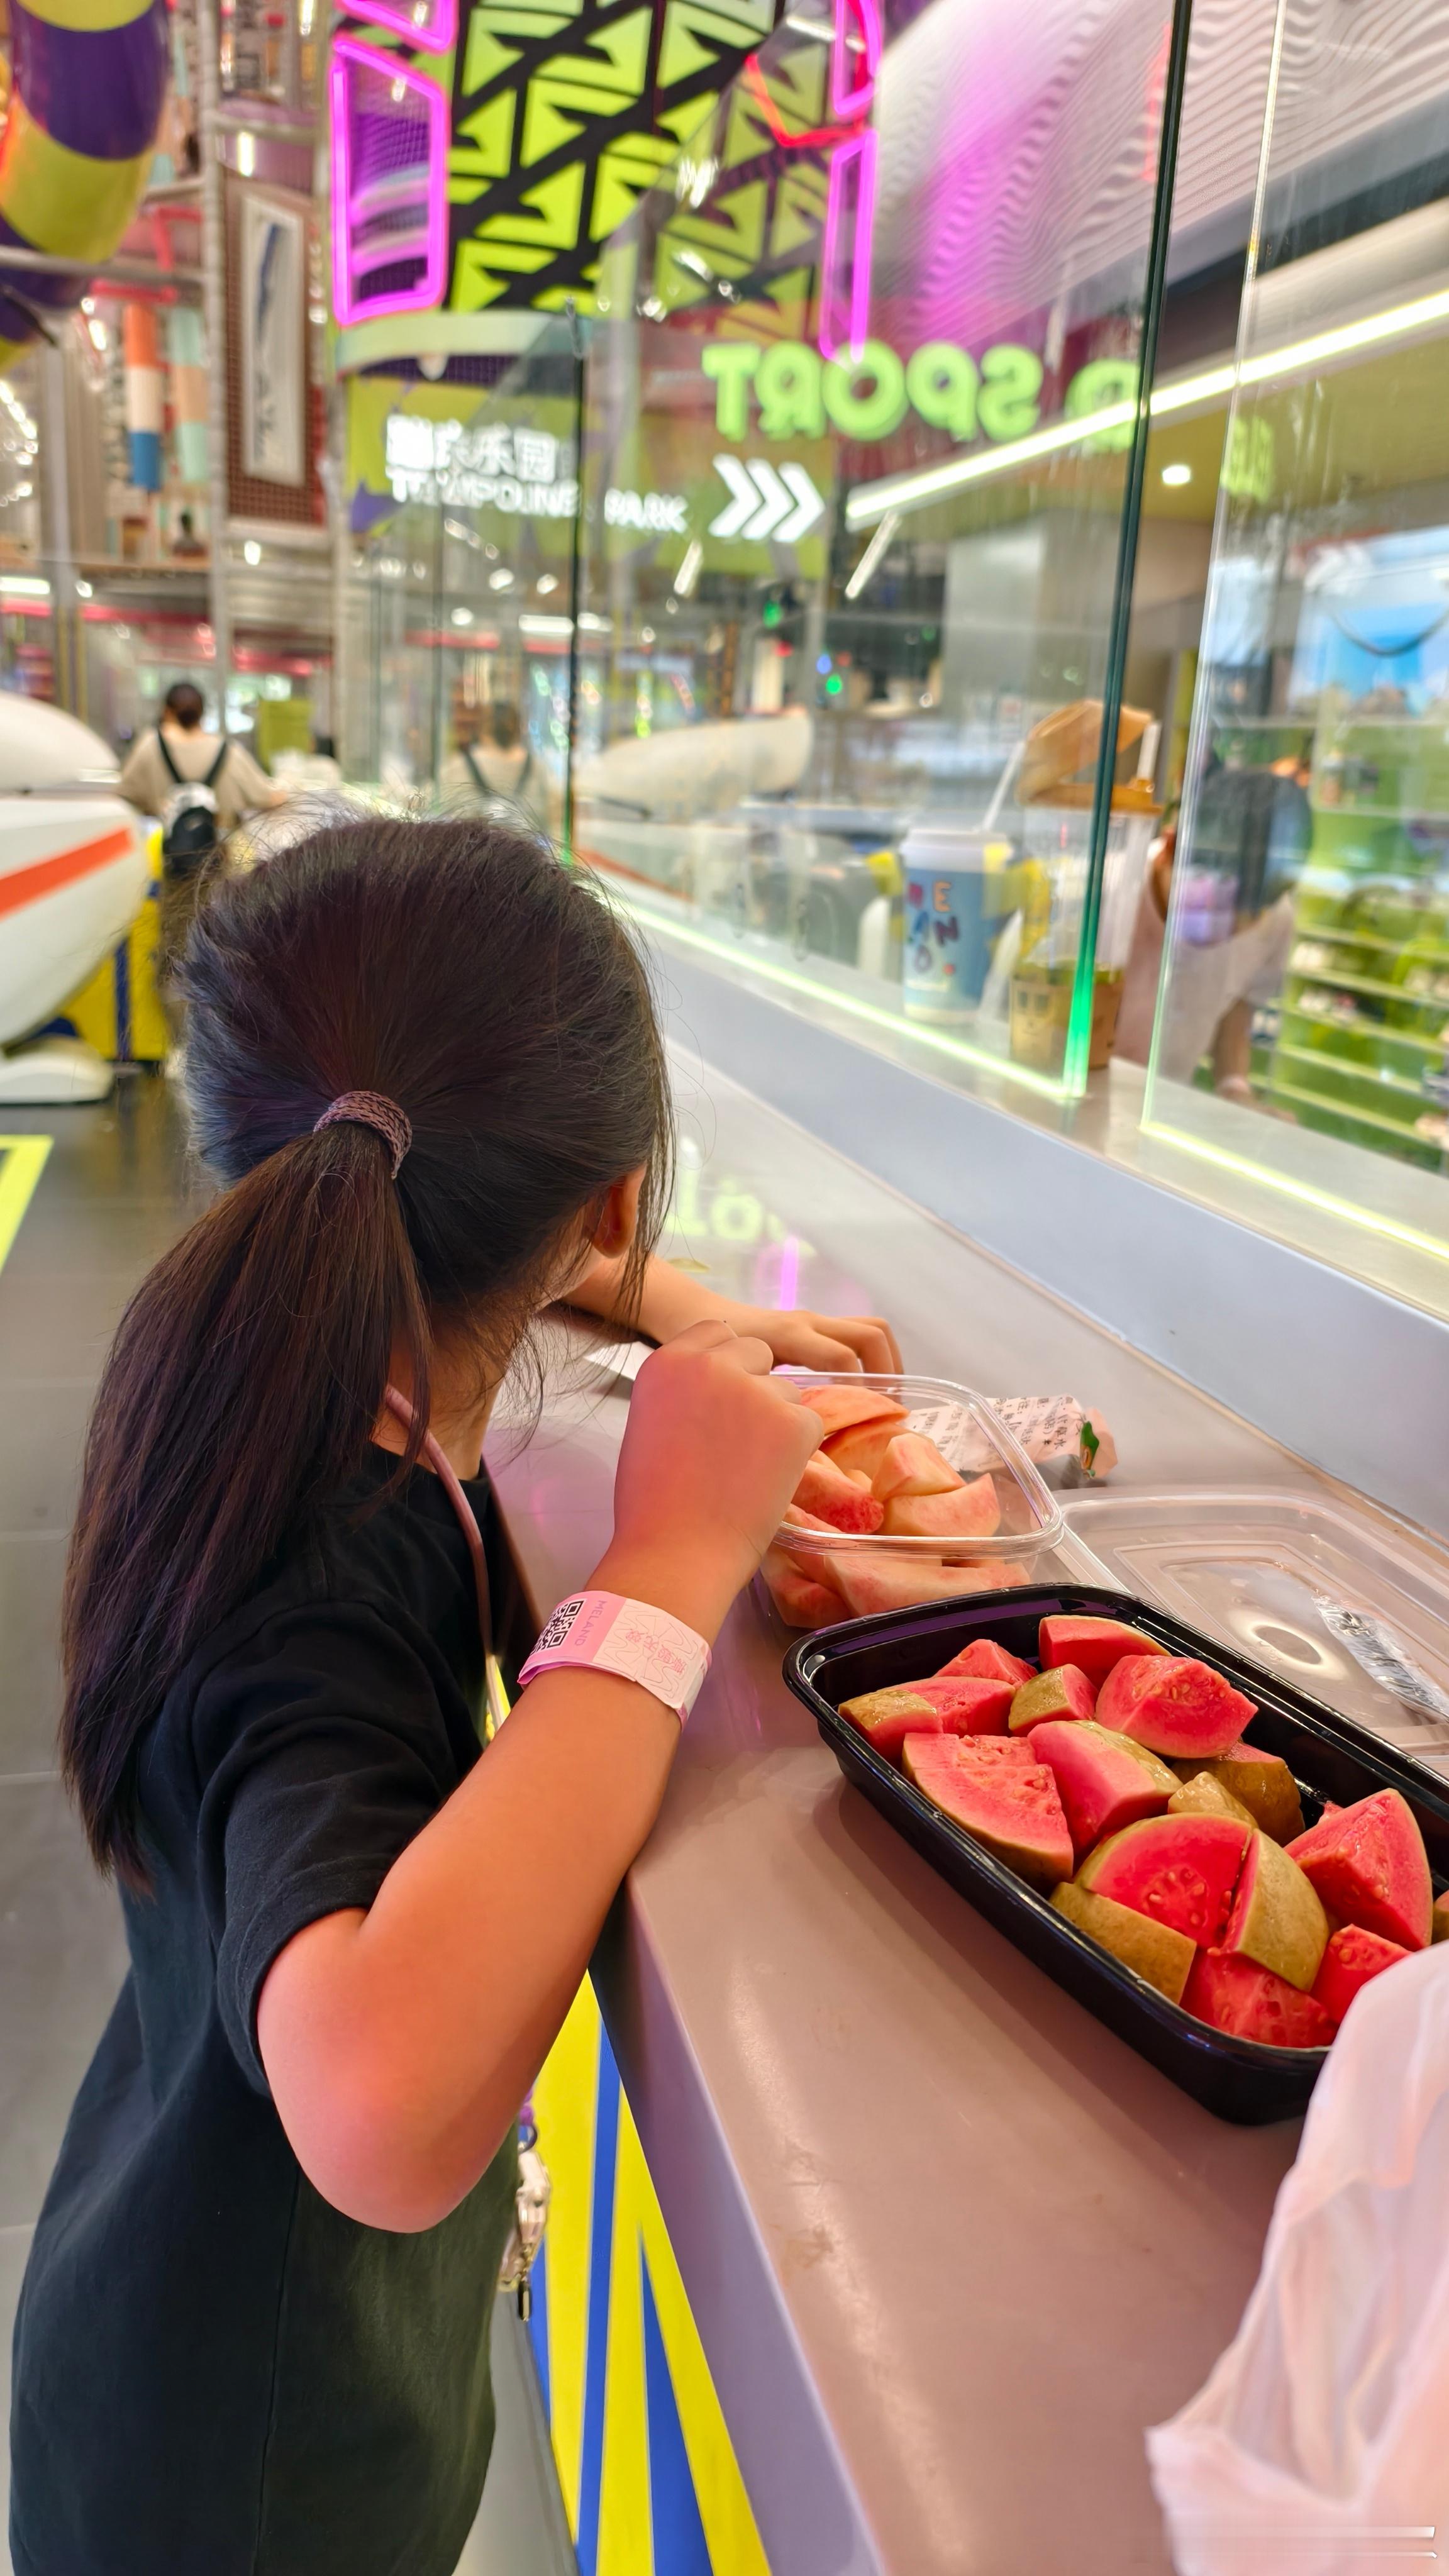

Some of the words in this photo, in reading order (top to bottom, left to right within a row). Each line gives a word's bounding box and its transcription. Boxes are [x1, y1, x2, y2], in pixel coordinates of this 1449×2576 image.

[386, 464, 580, 518] TMPOLINE
[604, 487, 689, 534] PARK
[575, 1599, 608, 1646] MELAND
